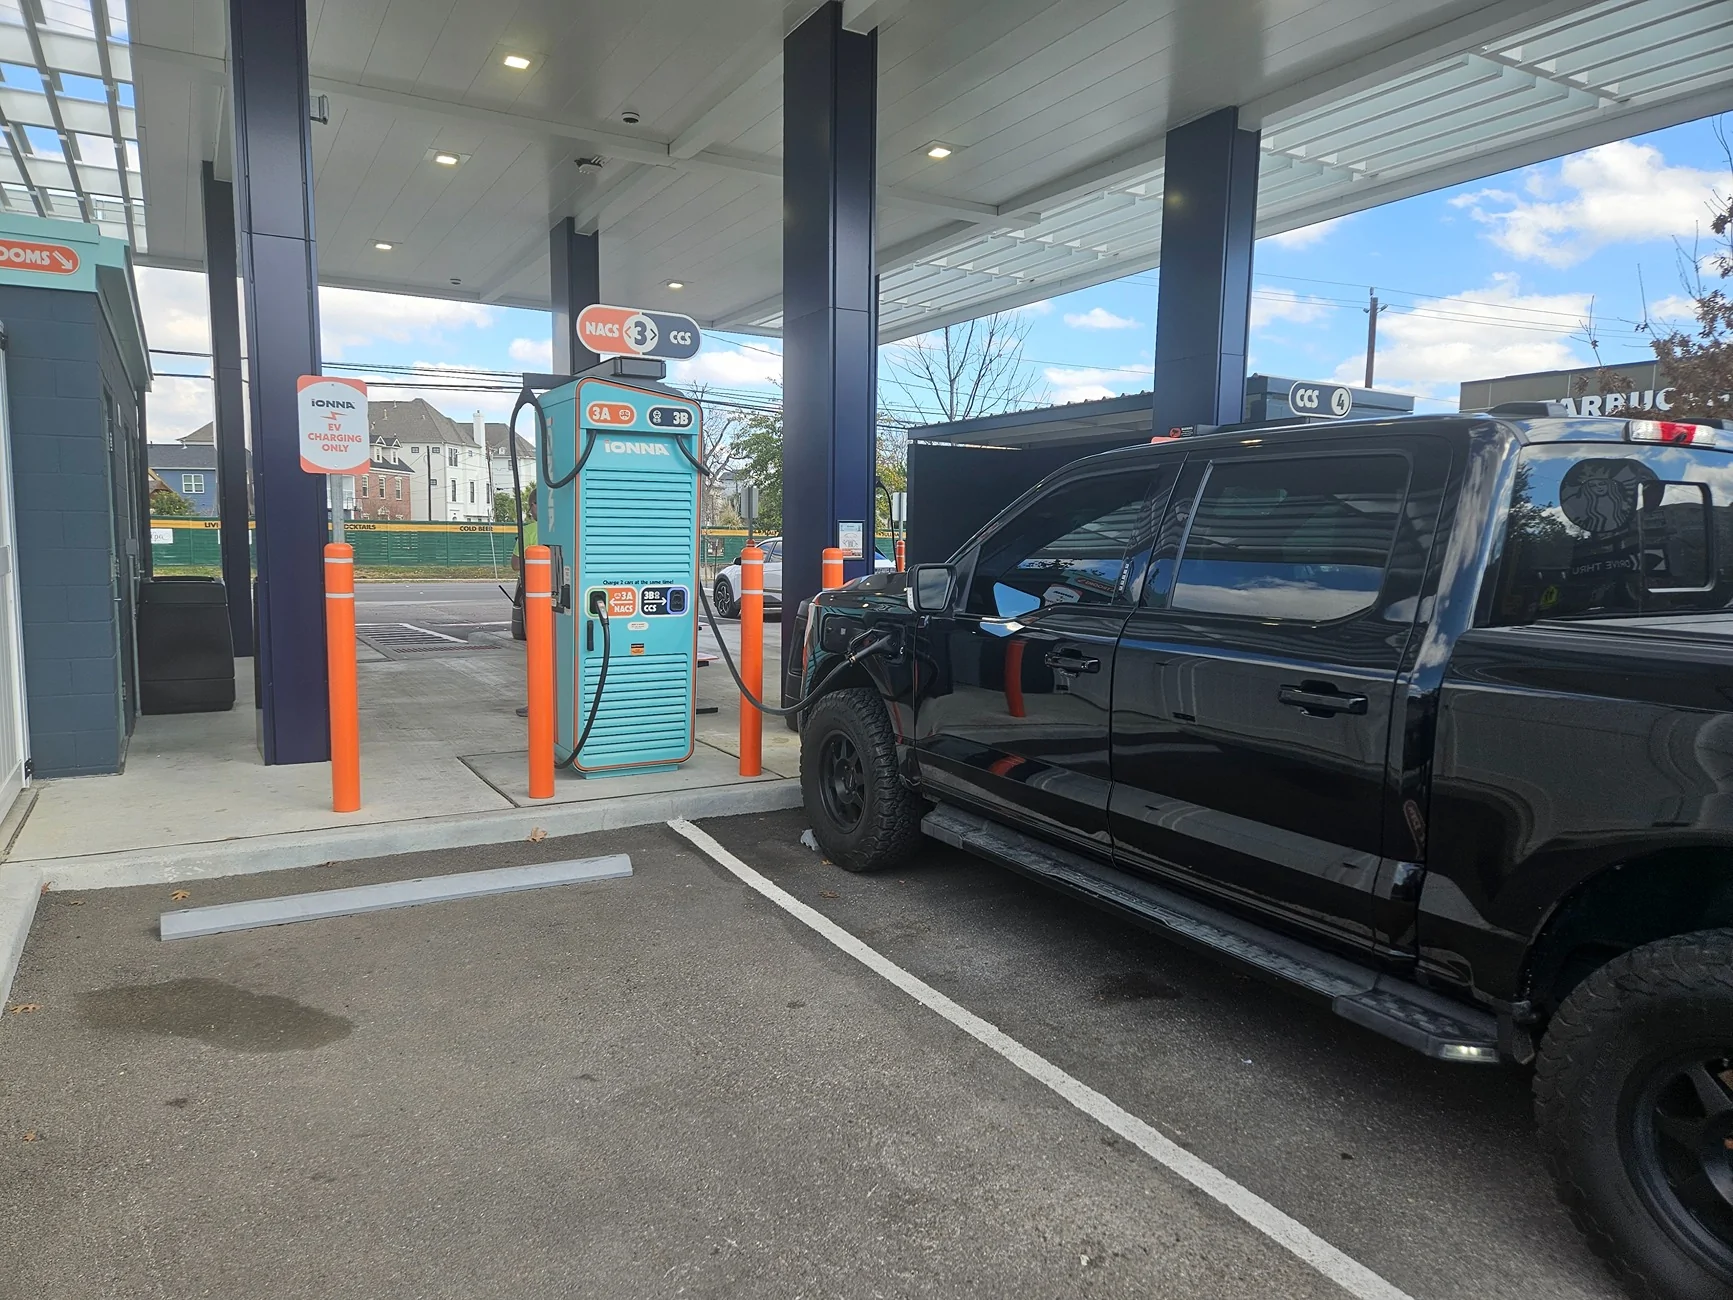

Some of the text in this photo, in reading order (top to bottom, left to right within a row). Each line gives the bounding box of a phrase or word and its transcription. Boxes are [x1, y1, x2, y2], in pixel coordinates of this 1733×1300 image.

[585, 320, 692, 346] NACS 3 CCS
[1296, 388, 1345, 410] CCS 4
[592, 406, 611, 421] 3A
[673, 411, 689, 425] 3B
[328, 423, 341, 431] EV
[307, 432, 362, 443] CHARGING
[321, 443, 349, 452] ONLY
[621, 591, 634, 600] 3A
[643, 591, 655, 600] 3B
[614, 605, 634, 613] NACS
[643, 604, 657, 612] CCS
